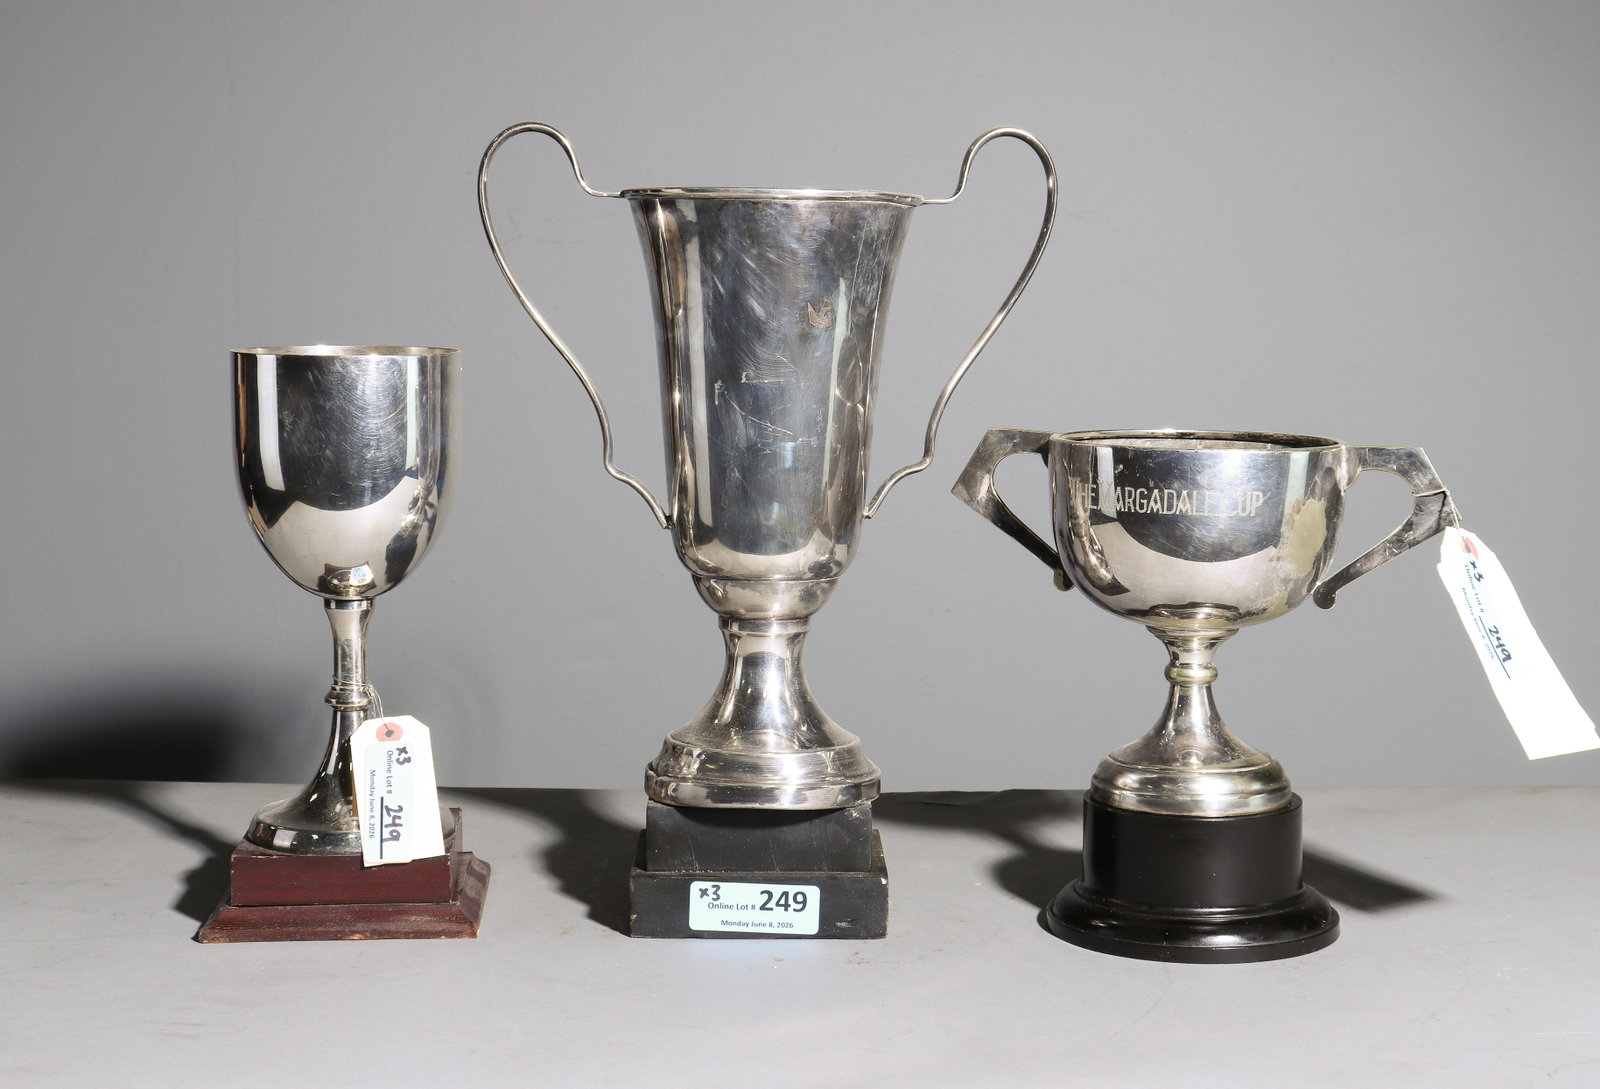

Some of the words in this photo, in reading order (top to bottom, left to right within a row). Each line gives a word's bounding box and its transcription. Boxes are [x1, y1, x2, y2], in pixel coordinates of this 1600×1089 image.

[1222, 487, 1264, 517] CUP
[1488, 625, 1512, 663] 249
[386, 750, 394, 774] Online
[368, 769, 376, 797] Monday
[382, 804, 404, 842] 249
[707, 902, 734, 911] Online
[736, 903, 749, 911] Lot
[759, 889, 808, 913] 249
[720, 919, 749, 928] Monday
[750, 920, 767, 928] June
[768, 921, 775, 929] 8,
[776, 921, 794, 929] 2026
